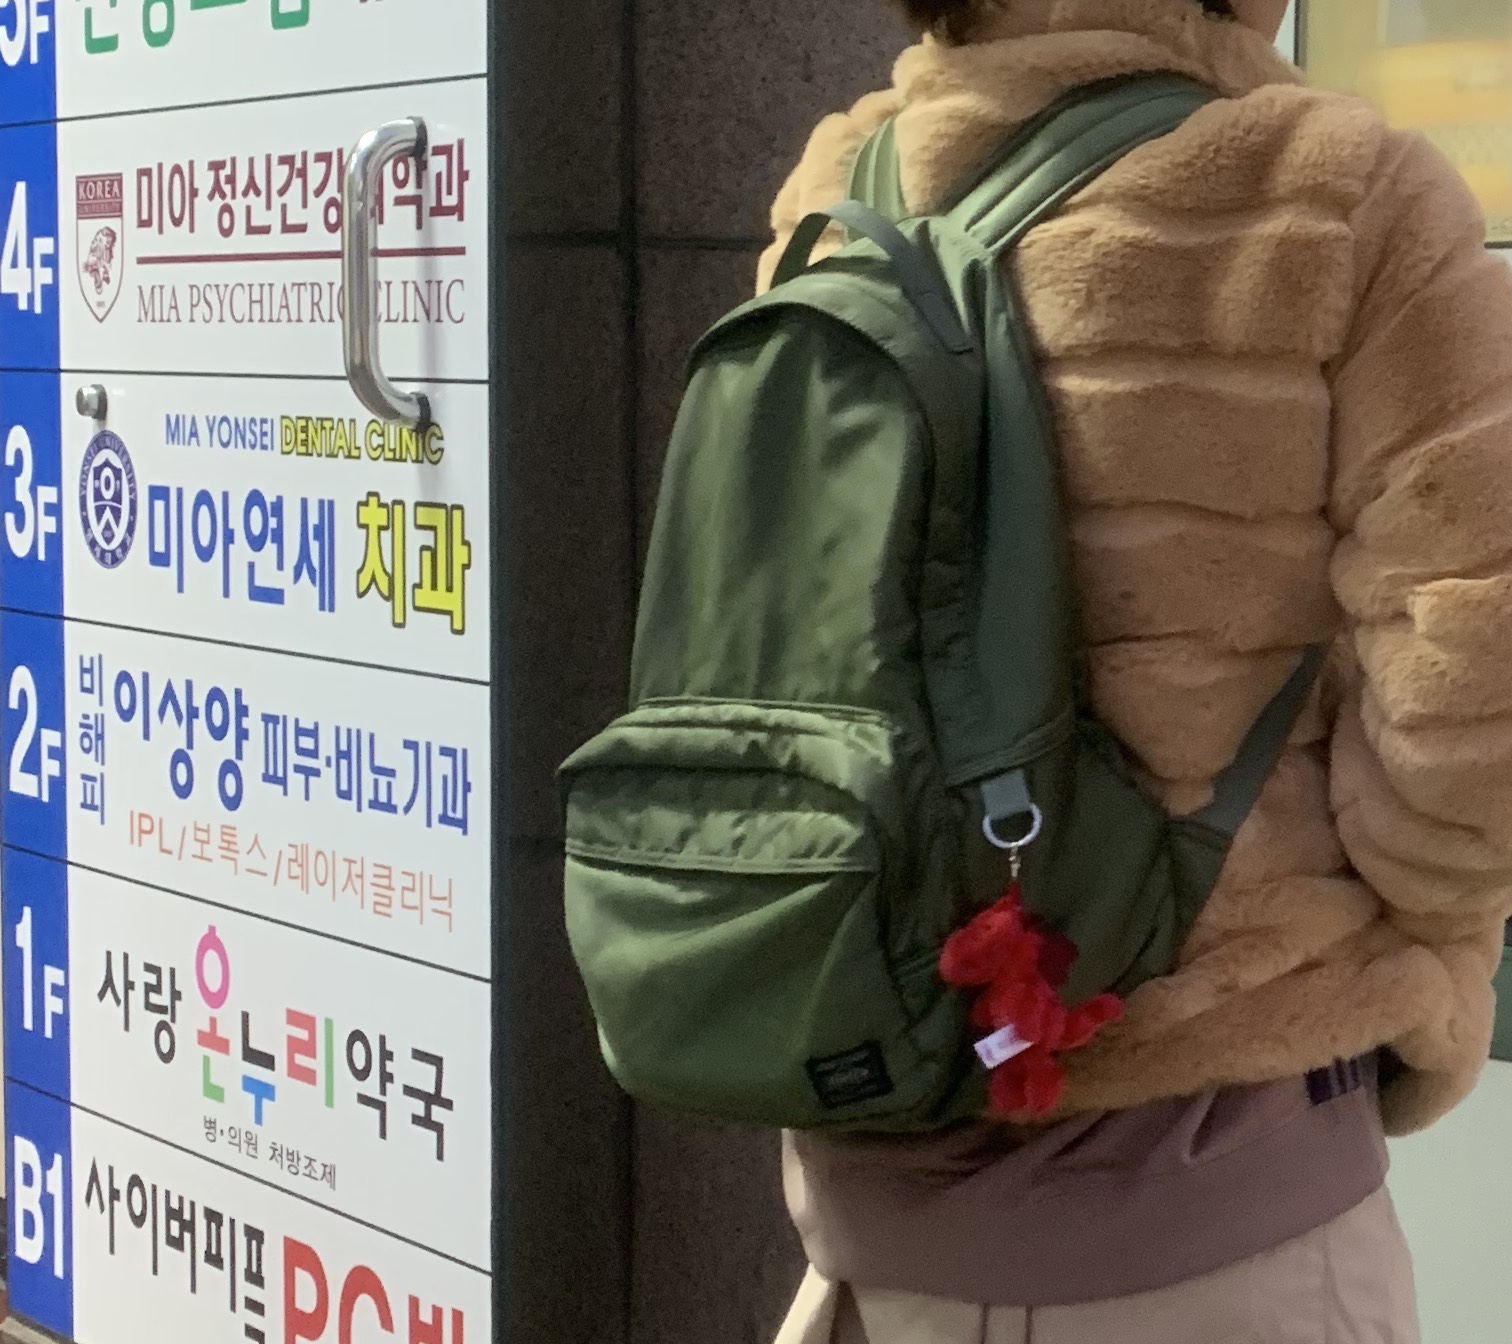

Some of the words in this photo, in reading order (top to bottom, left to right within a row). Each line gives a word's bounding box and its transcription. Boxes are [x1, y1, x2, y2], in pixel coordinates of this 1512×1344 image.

[0, 182, 54, 315] 4F
[78, 179, 120, 201] KOREA
[206, 138, 470, 238] 정신건강학과
[137, 281, 180, 325] MIA
[5, 424, 57, 561] 3F
[165, 413, 200, 447] MIA
[205, 415, 274, 451] YONSEI
[280, 415, 361, 460] DENTAL
[364, 418, 445, 465] CLINIC
[147, 483, 336, 613] 미아연세
[356, 491, 472, 635] 치과
[9, 665, 61, 803] 2F
[78, 653, 106, 825] 비해피
[113, 669, 250, 812] 이상양
[15, 906, 65, 1040] 1F
[14, 1135, 65, 1280] B1
[203, 1115, 258, 1160] 병·의원
[268, 1141, 336, 1191] 처방조제
